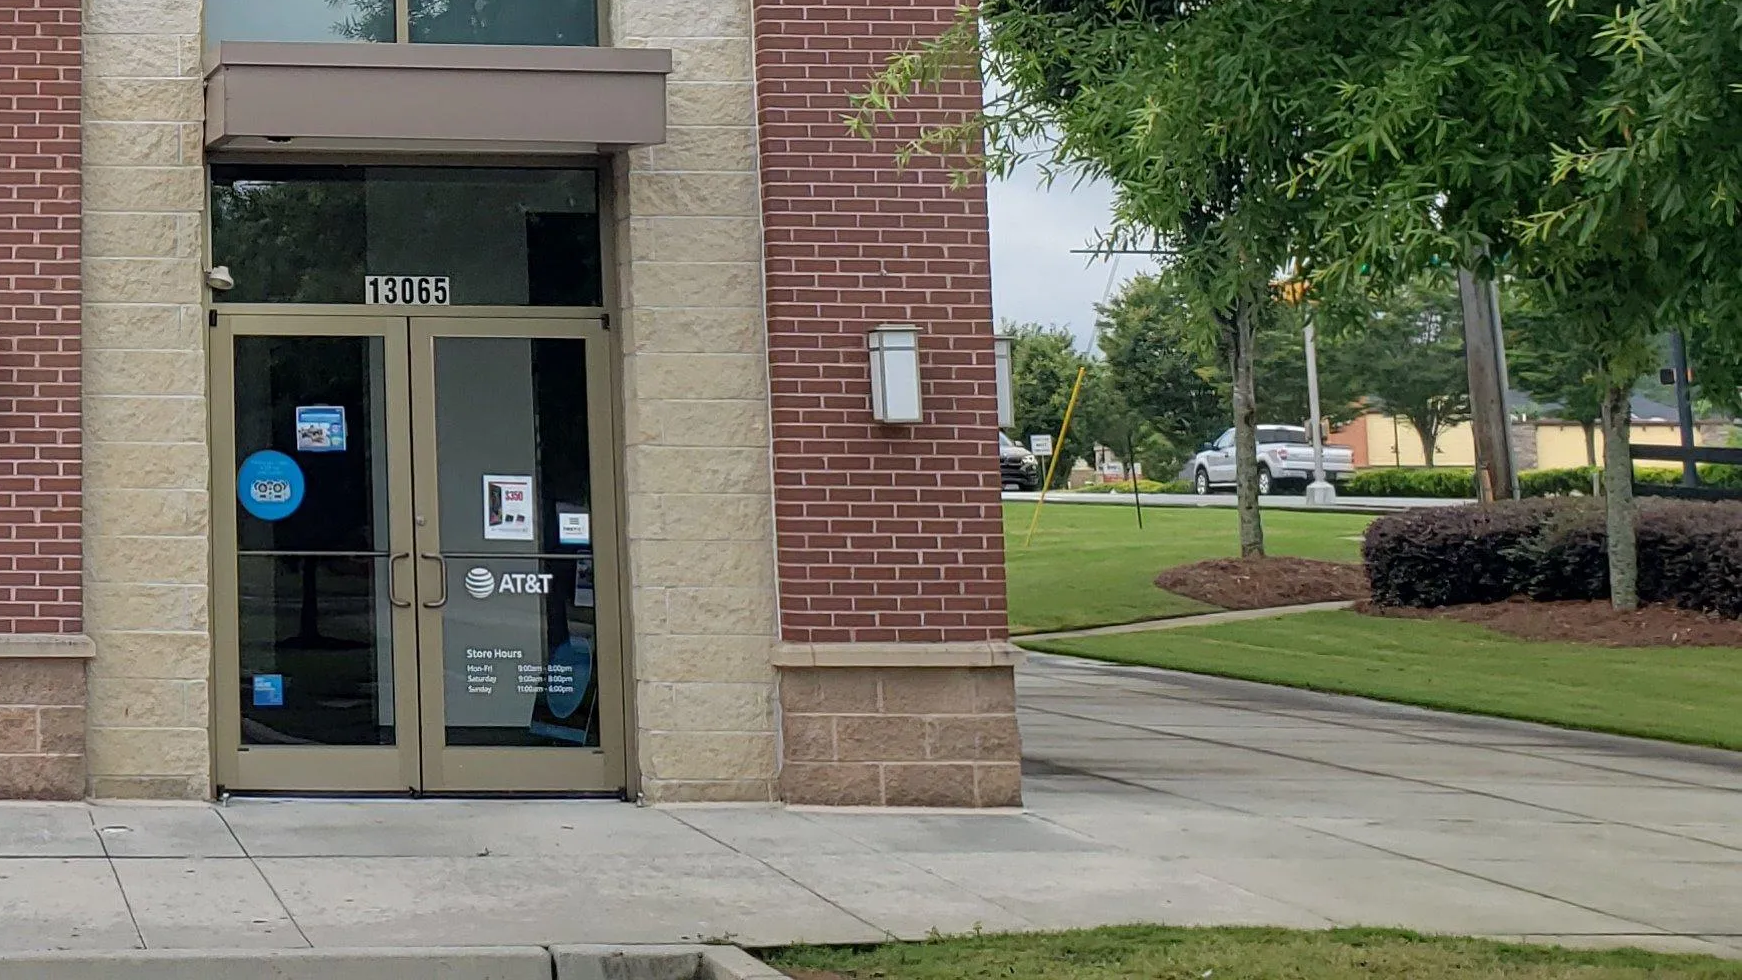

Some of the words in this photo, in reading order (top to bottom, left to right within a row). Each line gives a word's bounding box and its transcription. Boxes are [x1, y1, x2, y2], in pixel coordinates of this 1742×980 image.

[369, 277, 447, 304] 13065
[498, 573, 553, 594] AT&T
[466, 649, 493, 659] Store
[494, 649, 523, 659] Hours
[467, 675, 497, 684] Saturday
[467, 685, 492, 694] Sunday
